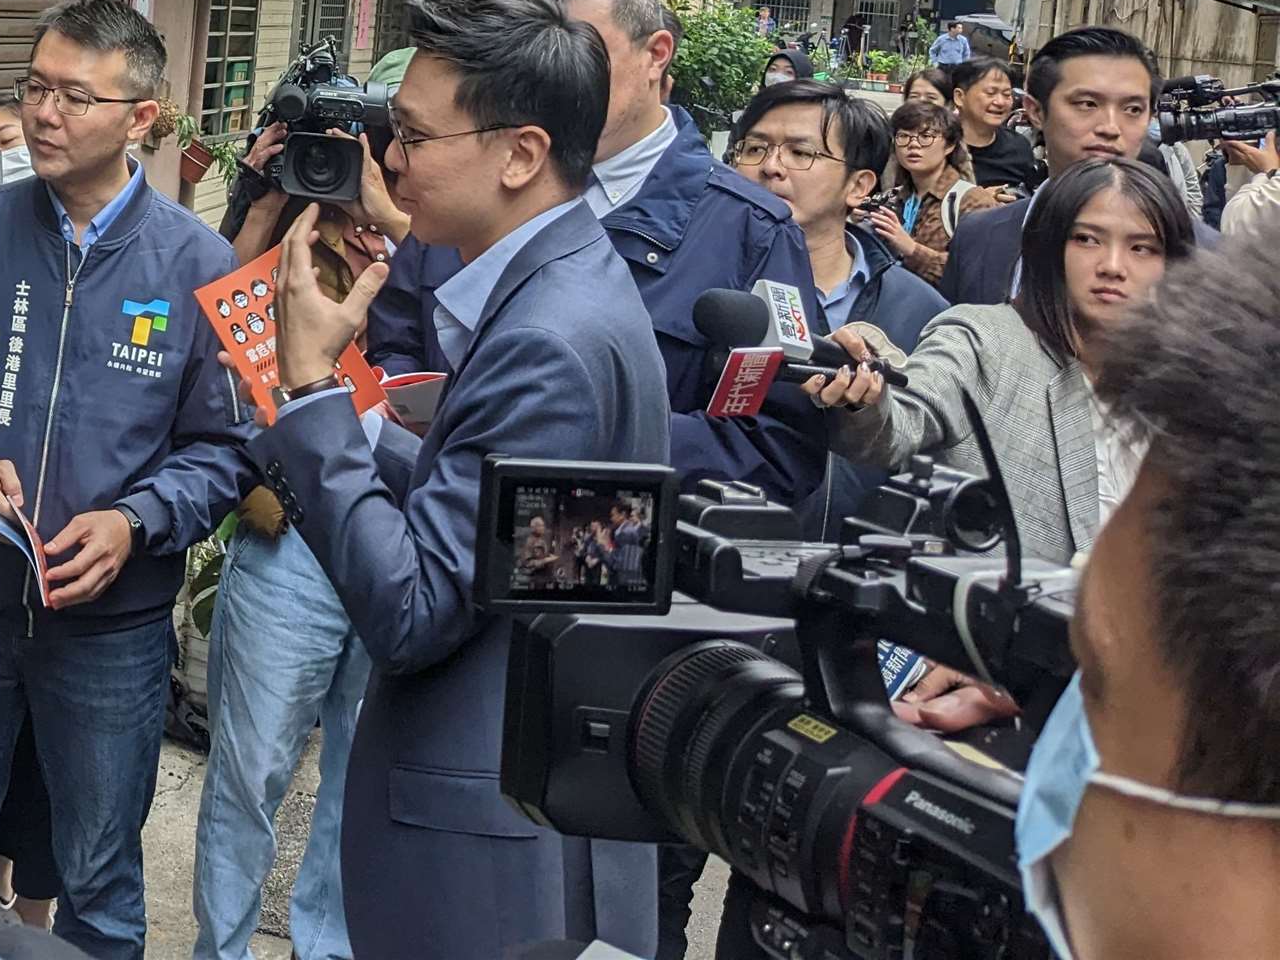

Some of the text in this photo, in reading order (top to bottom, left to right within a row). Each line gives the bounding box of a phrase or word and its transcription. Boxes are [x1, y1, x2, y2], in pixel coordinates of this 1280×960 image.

[771, 286, 798, 340] 壹新聞
[112, 342, 164, 367] TAIPEI
[721, 353, 771, 414] 年代新聞
[904, 790, 977, 835] Panasonic
